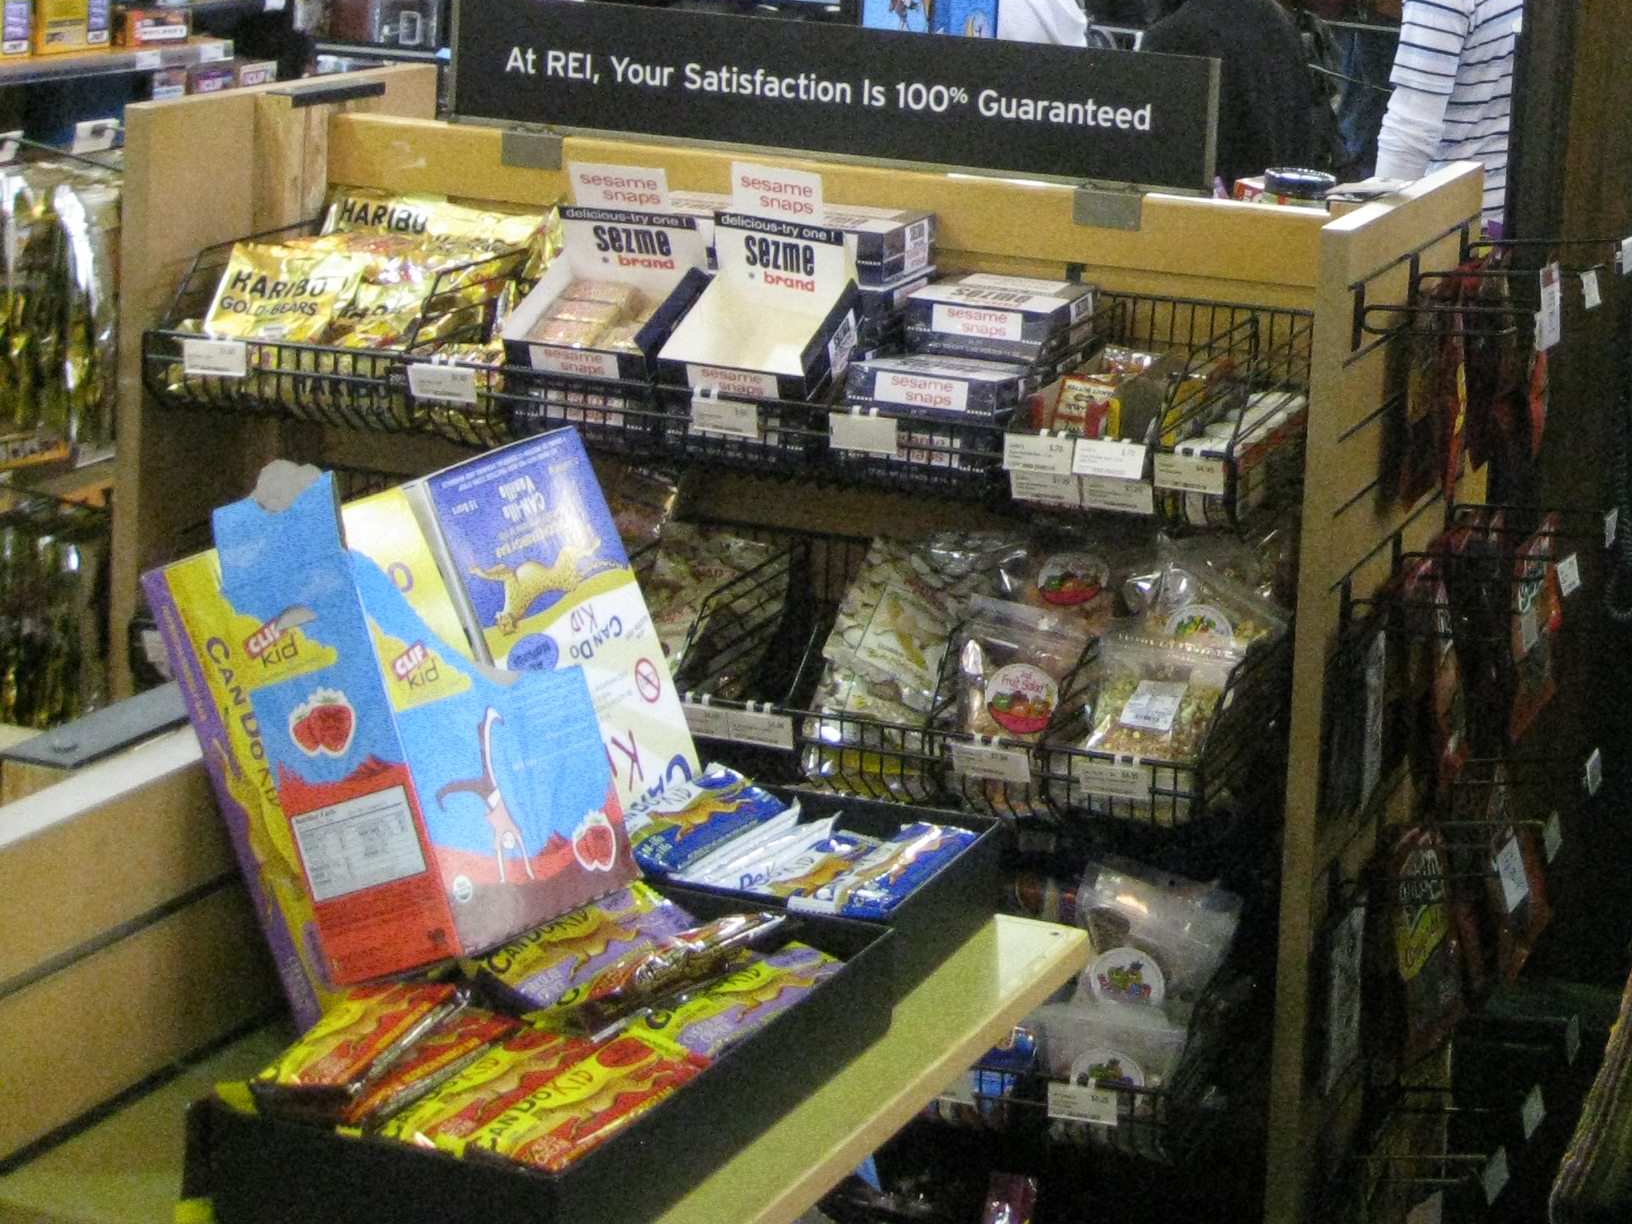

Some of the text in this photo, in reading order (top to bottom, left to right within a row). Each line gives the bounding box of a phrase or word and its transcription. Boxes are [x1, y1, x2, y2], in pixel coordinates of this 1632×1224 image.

[505, 46, 1151, 131] At REI, Your Satisfaction Is 100% Guaranteed
[580, 173, 658, 191] sesame
[741, 175, 813, 198] sesame
[603, 185, 662, 206] snaps
[760, 193, 814, 214] snaps
[340, 198, 428, 234] HARIBO
[566, 207, 648, 226] delicious-try
[652, 215, 680, 226] one
[721, 213, 797, 237] delicious-try
[802, 226, 828, 240] one
[593, 225, 672, 256] sezme
[617, 255, 675, 270] brand
[744, 234, 815, 276] sezme
[230, 270, 328, 300] HARIBO
[763, 270, 815, 292] brand
[219, 295, 319, 317] GOLD-BEARS
[946, 304, 1008, 324] sesame
[961, 321, 1007, 338] snaps
[544, 347, 603, 364] sesame
[560, 360, 605, 376] snaps
[701, 368, 762, 384] sesame
[718, 380, 764, 397] snaps
[890, 374, 954, 393] sesame
[905, 389, 952, 407] snaps
[499, 475, 537, 502] Vanilla
[570, 603, 602, 634] KID
[593, 615, 623, 648] CAN
[261, 634, 298, 668] kid
[394, 644, 428, 674] CLIF
[569, 642, 595, 660] DO
[206, 636, 246, 706] CAN
[406, 658, 439, 690] kid
[552, 1069, 594, 1096] KID
